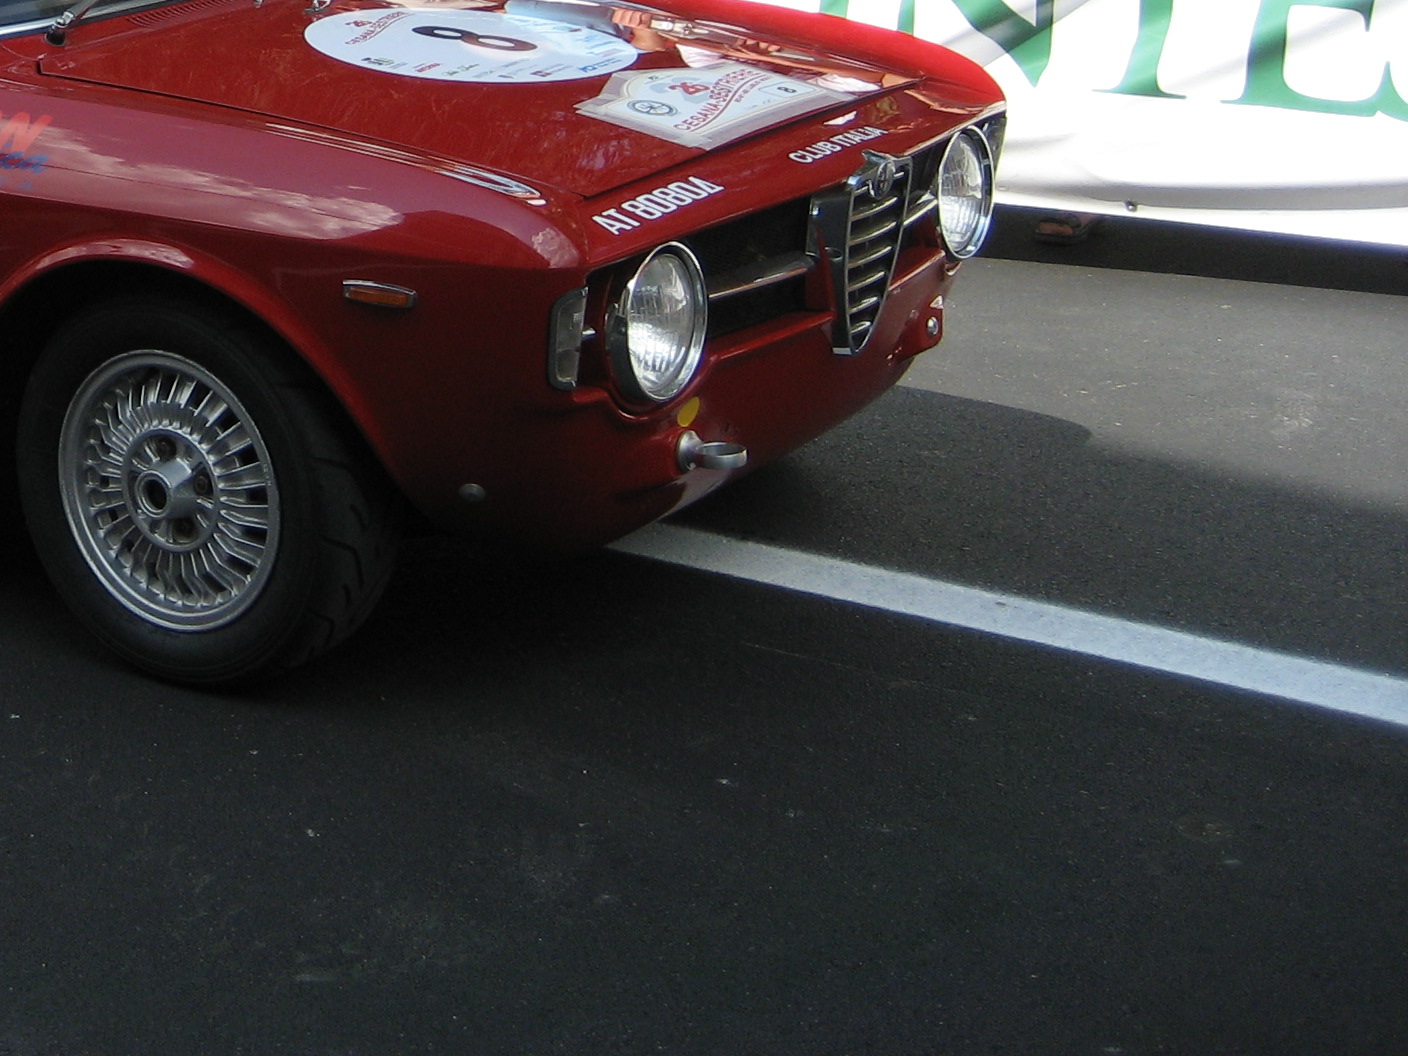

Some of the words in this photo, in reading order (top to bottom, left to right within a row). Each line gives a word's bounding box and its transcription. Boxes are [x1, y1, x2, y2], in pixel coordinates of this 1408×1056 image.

[411, 26, 538, 52] 8
[776, 86, 797, 94] 8
[788, 140, 841, 164] CLUB
[835, 126, 889, 148] ITALIA
[591, 207, 641, 236] AT
[620, 175, 725, 220] 80804
